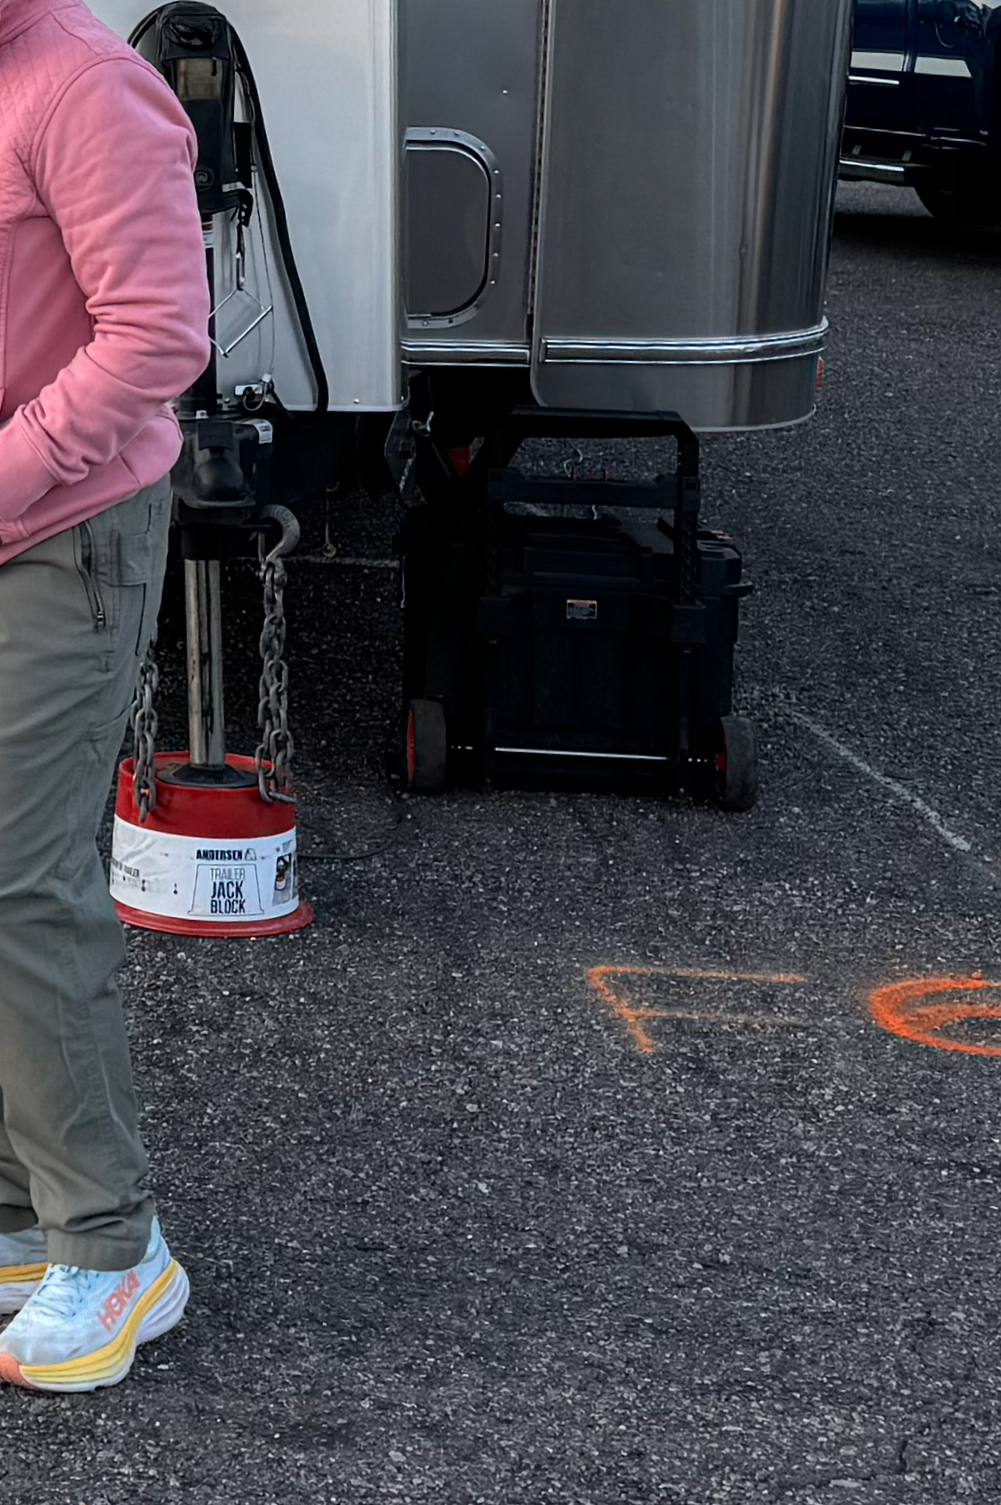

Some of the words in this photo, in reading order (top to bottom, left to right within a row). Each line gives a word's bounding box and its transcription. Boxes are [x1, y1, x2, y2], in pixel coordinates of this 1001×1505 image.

[196, 848, 243, 861] ANDERSEN
[210, 867, 246, 880] TRAILER
[210, 880, 244, 899] JACK
[210, 899, 246, 914] BLOCK
[96, 1269, 141, 1334] HOKA
